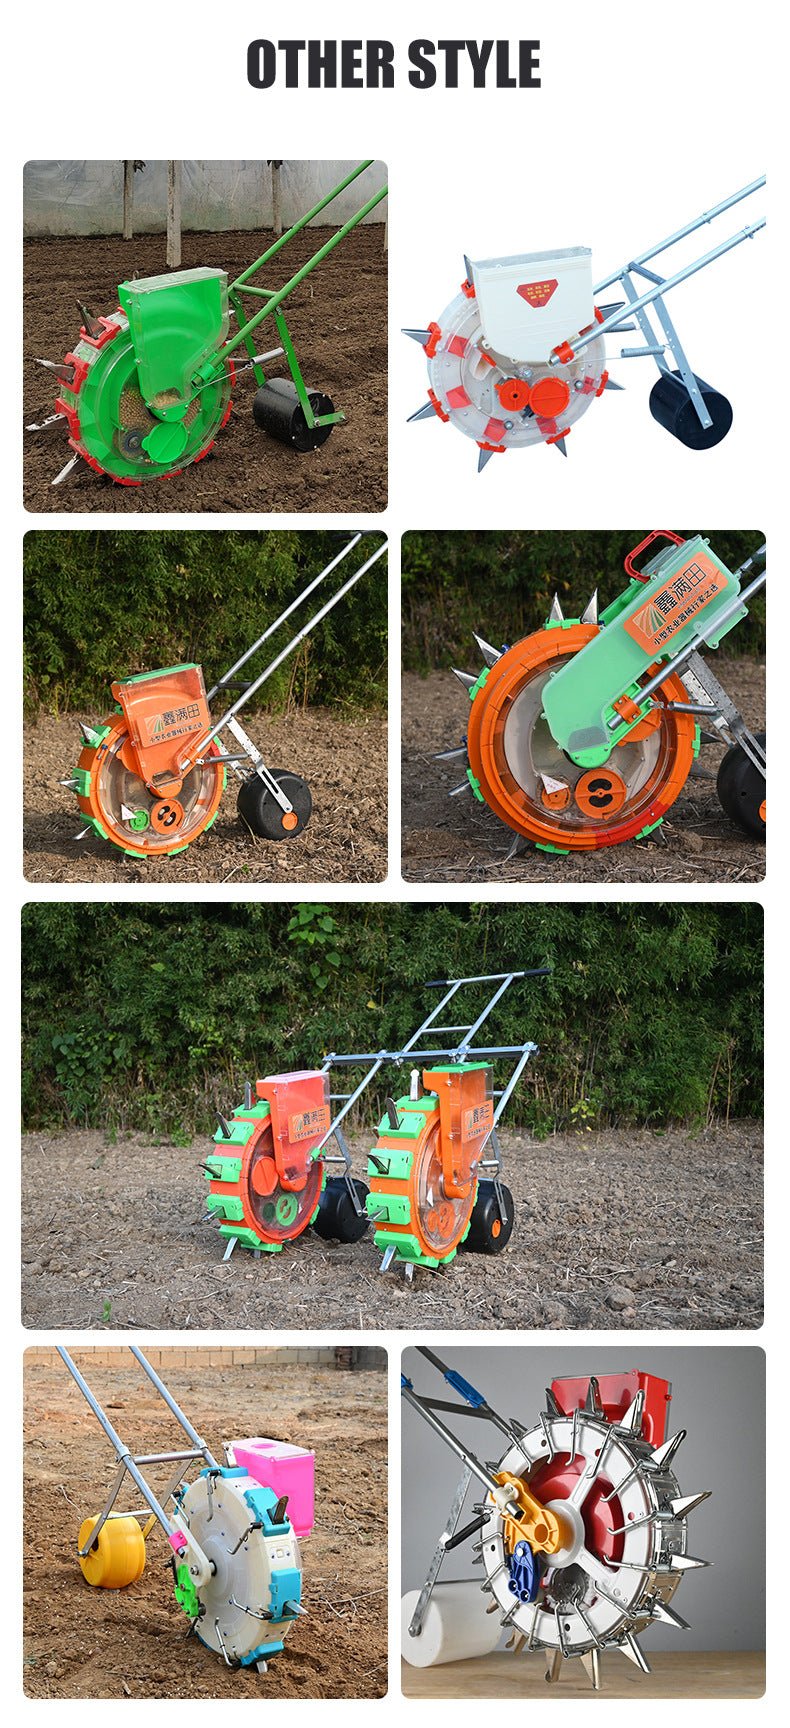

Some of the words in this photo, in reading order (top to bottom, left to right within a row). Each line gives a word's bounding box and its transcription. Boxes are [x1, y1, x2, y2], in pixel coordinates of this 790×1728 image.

[653, 562, 707, 615] 鑫满田
[654, 583, 719, 645] 小型农业器械行家之选
